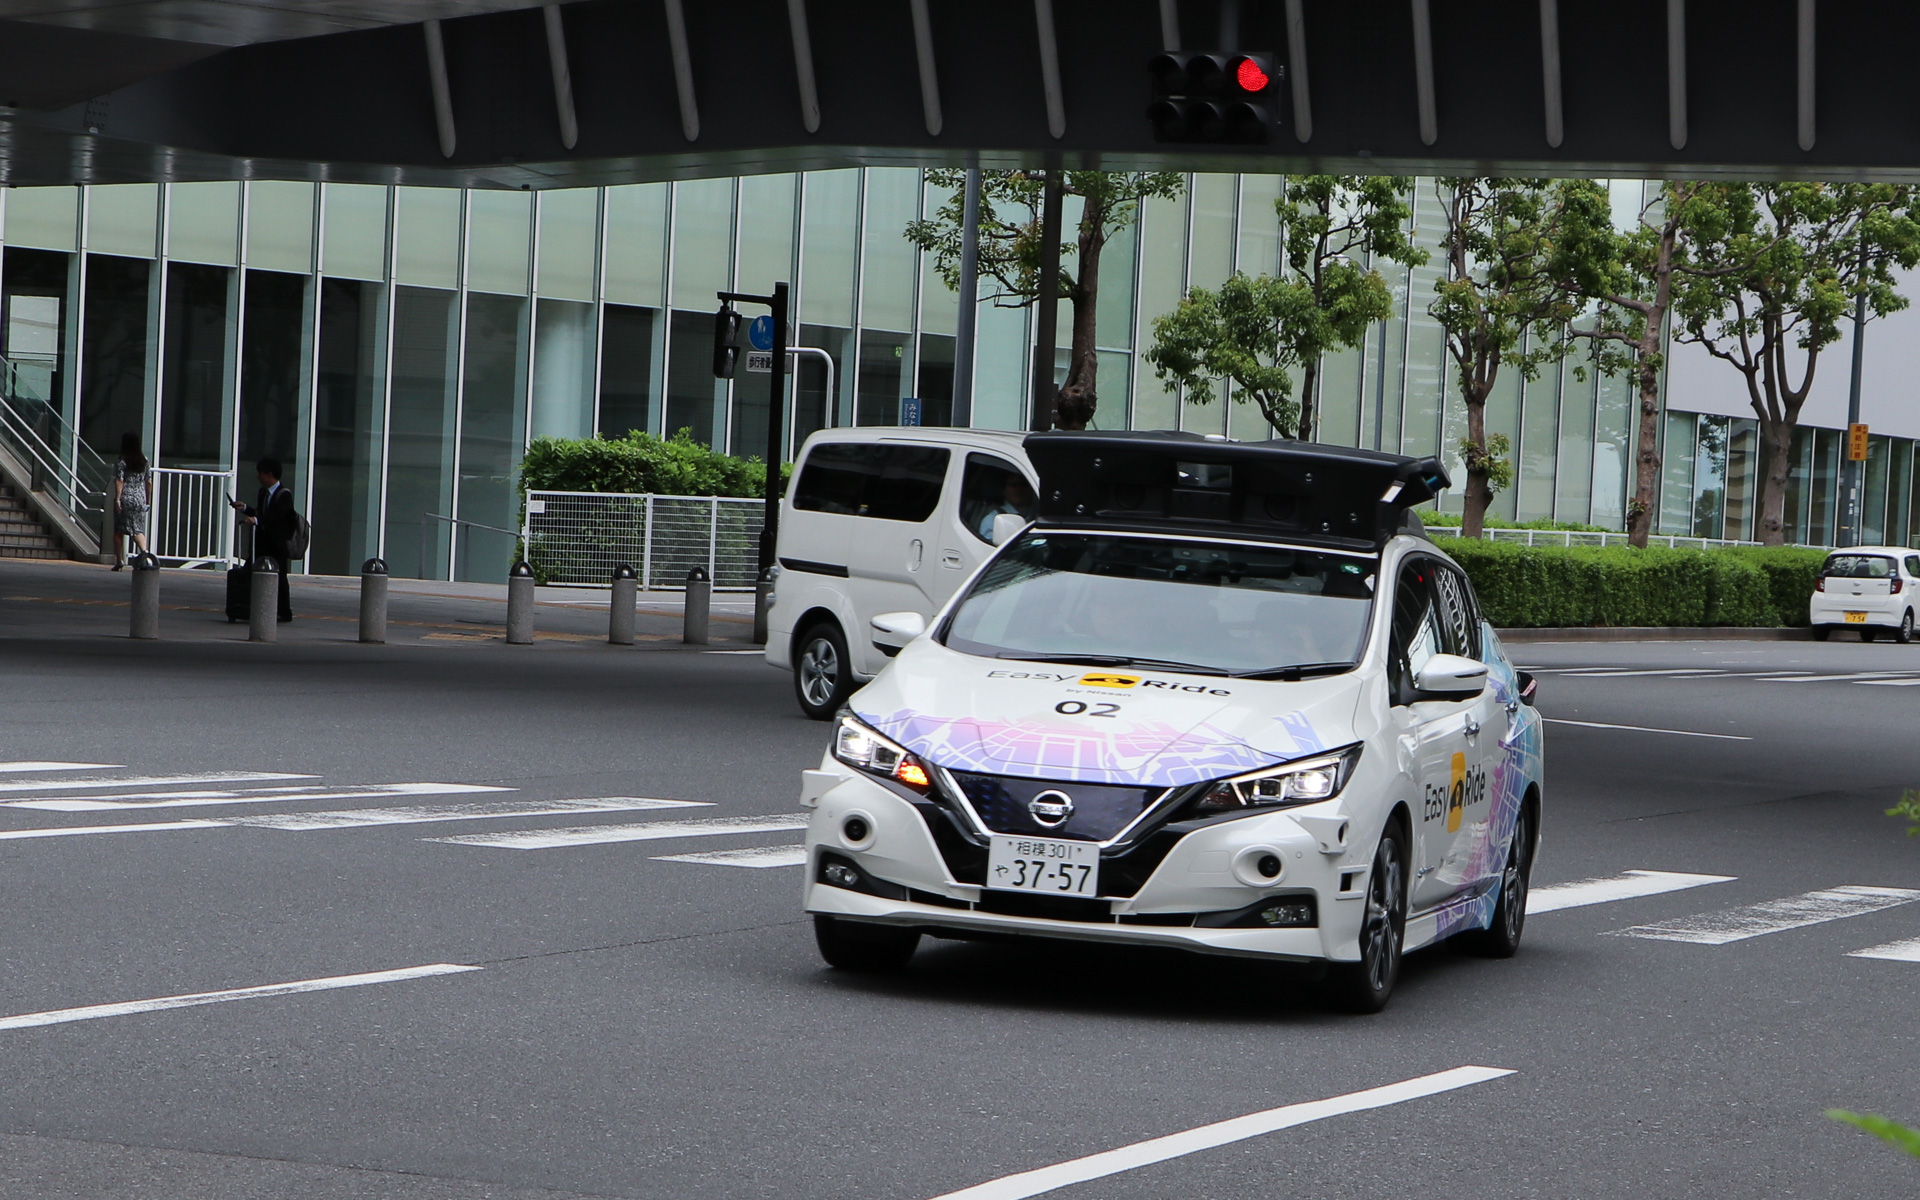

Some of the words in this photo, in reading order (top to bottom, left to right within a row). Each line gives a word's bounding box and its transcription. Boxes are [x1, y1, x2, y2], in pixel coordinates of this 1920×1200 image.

[748, 356, 772, 369] 歩行者優
[987, 670, 1077, 682] Easy
[1142, 680, 1232, 697] Ride
[1055, 701, 1121, 718] 02
[1424, 783, 1450, 827] Easy
[1464, 764, 1486, 807] Ride
[995, 864, 1009, 877] や
[1012, 859, 1092, 892] 37-57
